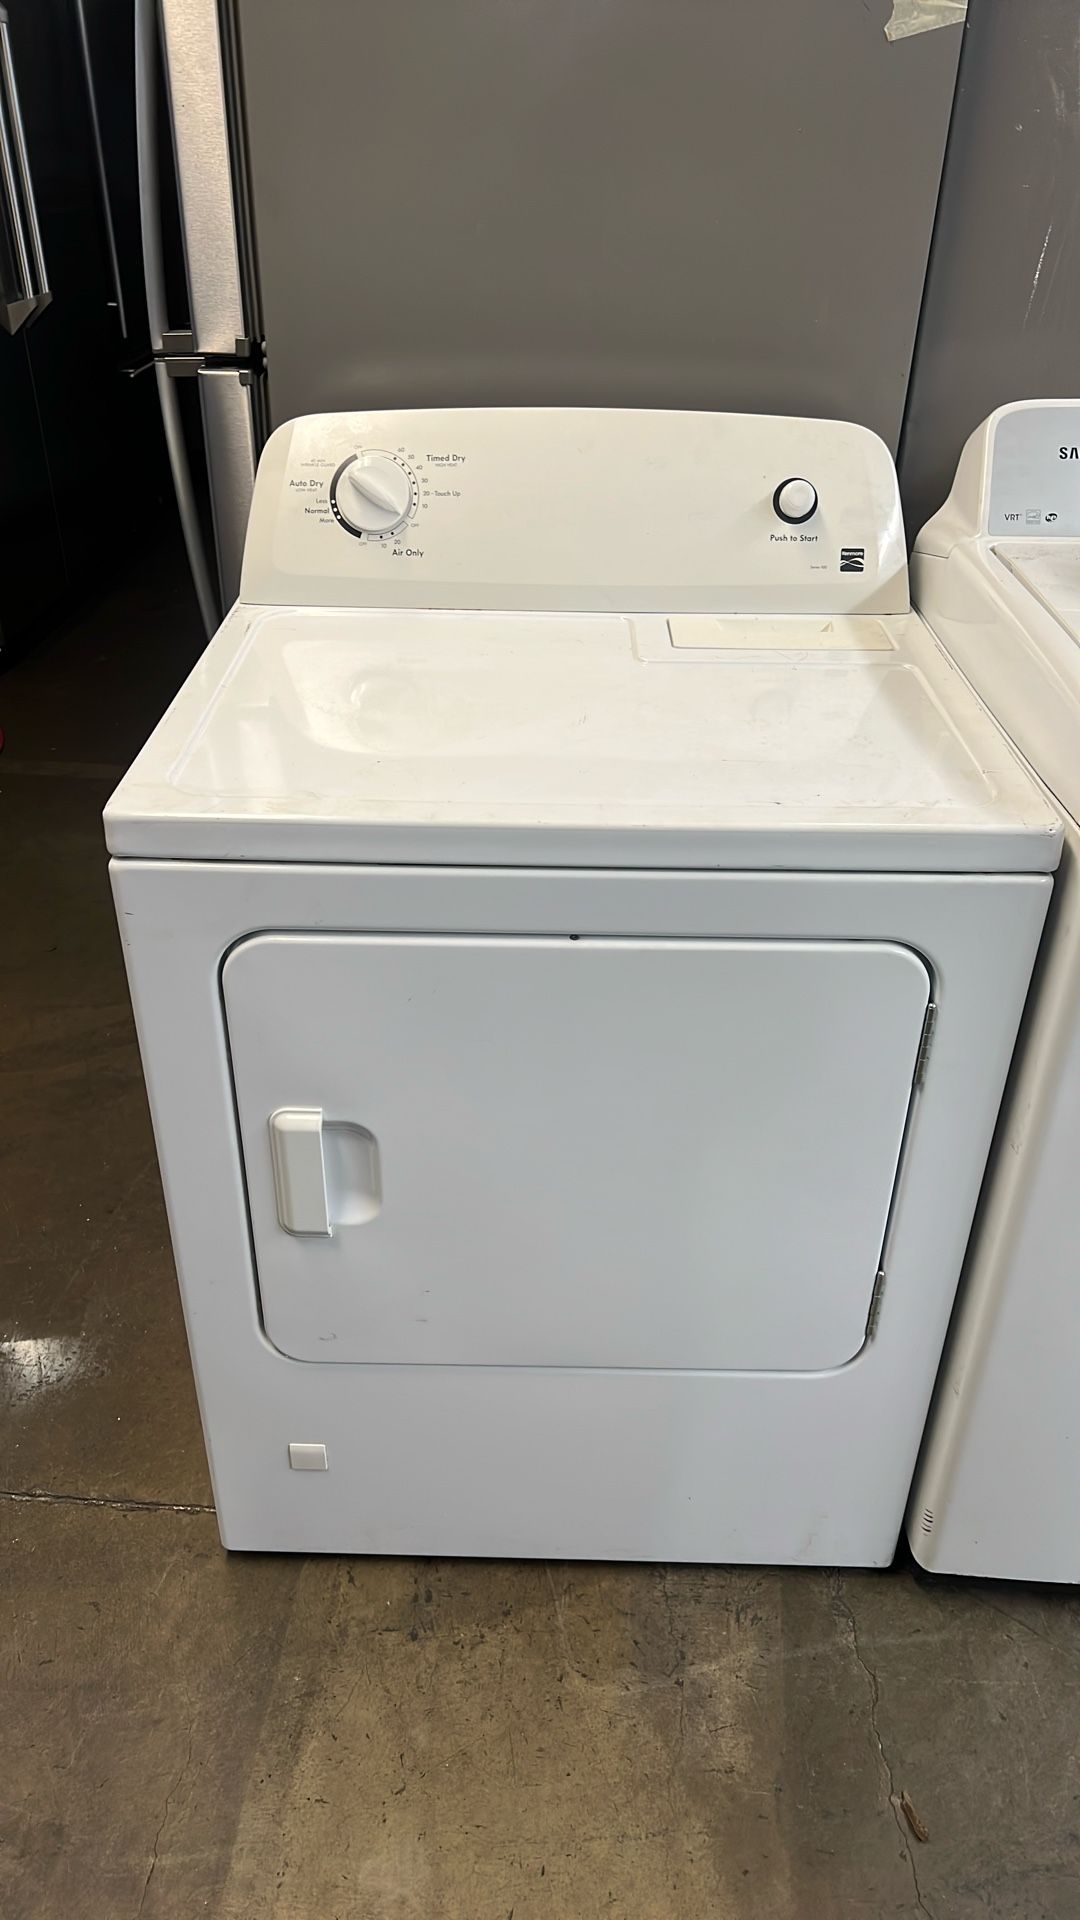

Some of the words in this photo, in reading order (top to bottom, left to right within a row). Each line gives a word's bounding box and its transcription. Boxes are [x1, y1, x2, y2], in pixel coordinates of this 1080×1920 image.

[426, 454, 450, 462] Timed
[452, 454, 466, 463] Dry
[309, 480, 324, 488] Dry
[452, 490, 461, 498] Up
[769, 534, 788, 542] Push
[790, 534, 798, 542] to
[799, 534, 818, 542] Start
[405, 548, 425, 558] Only
